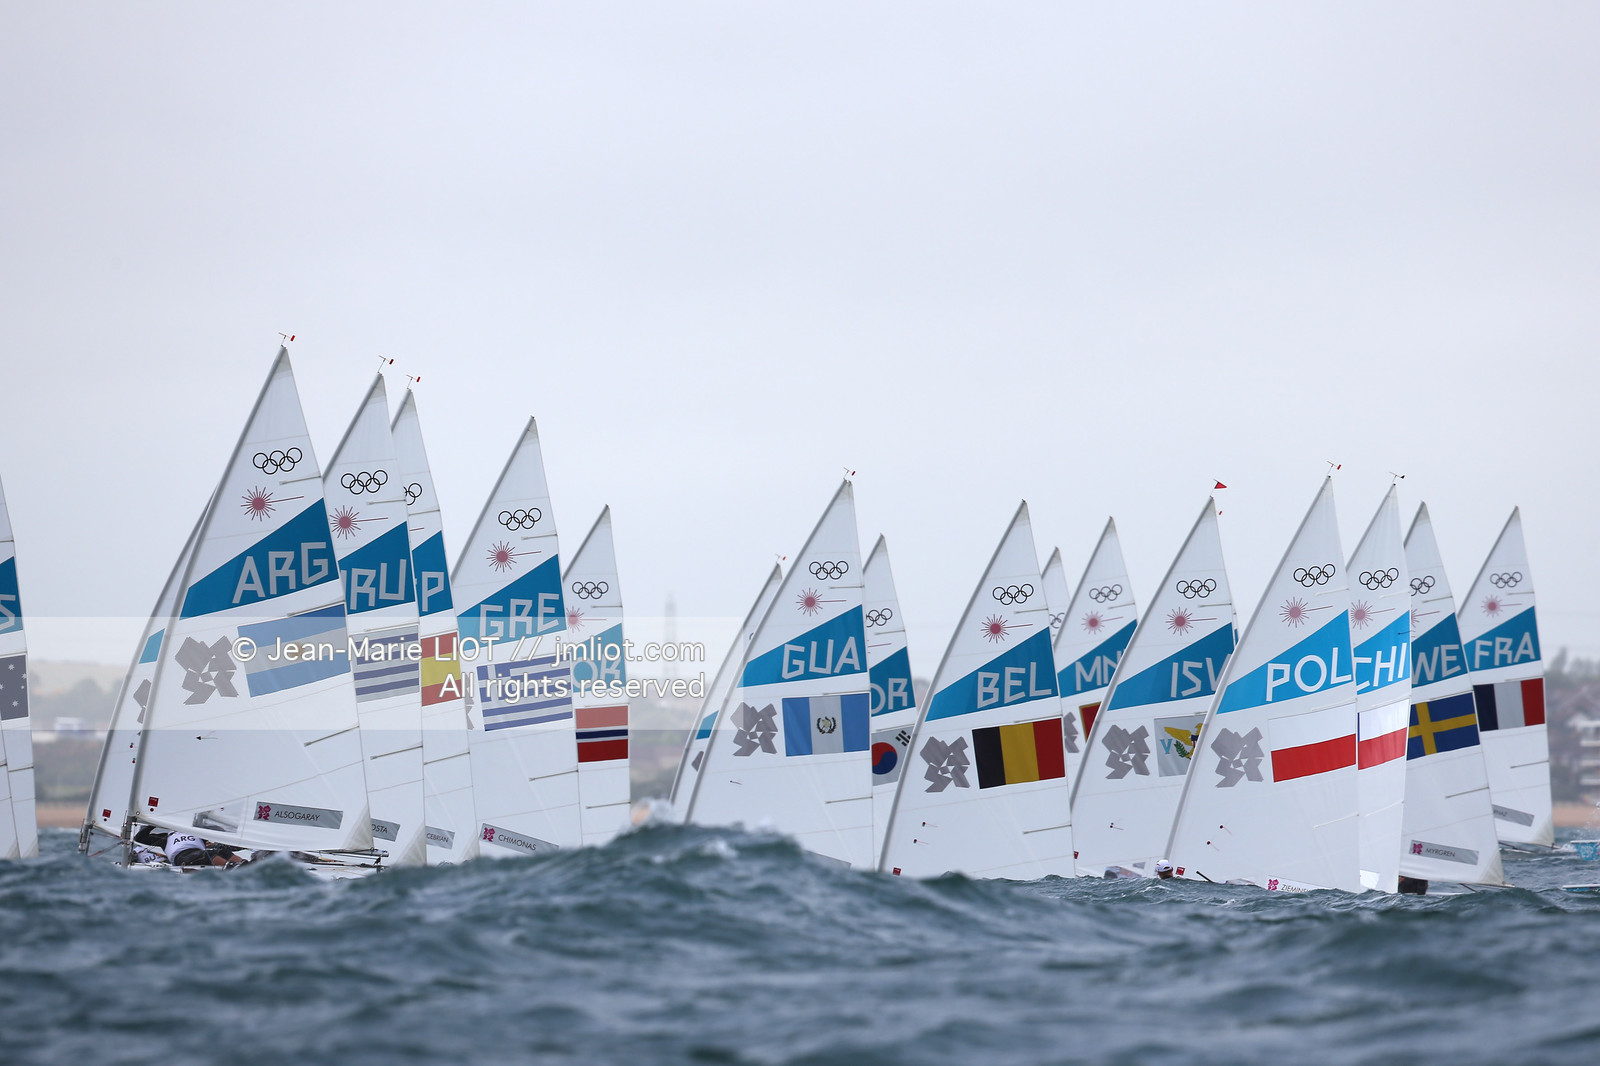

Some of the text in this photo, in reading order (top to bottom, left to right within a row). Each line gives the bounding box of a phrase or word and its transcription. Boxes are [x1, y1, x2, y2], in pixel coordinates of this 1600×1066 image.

[232, 541, 329, 604] ARG
[479, 592, 560, 643] GRE
[781, 636, 861, 680] GUA
[1074, 650, 1123, 692] MN
[1353, 642, 1407, 692] CHI
[1411, 643, 1462, 685] WE
[1474, 631, 1536, 669] FRA
[572, 653, 622, 690] OR
[977, 661, 1052, 709] BEL
[1170, 653, 1233, 698] ISV
[1265, 647, 1353, 702] POL
[870, 677, 908, 715] OR
[274, 810, 321, 822] ALSOGARAY
[371, 823, 389, 834] OSTA
[173, 835, 196, 846] ARG
[498, 834, 537, 851] CHIMONAS
